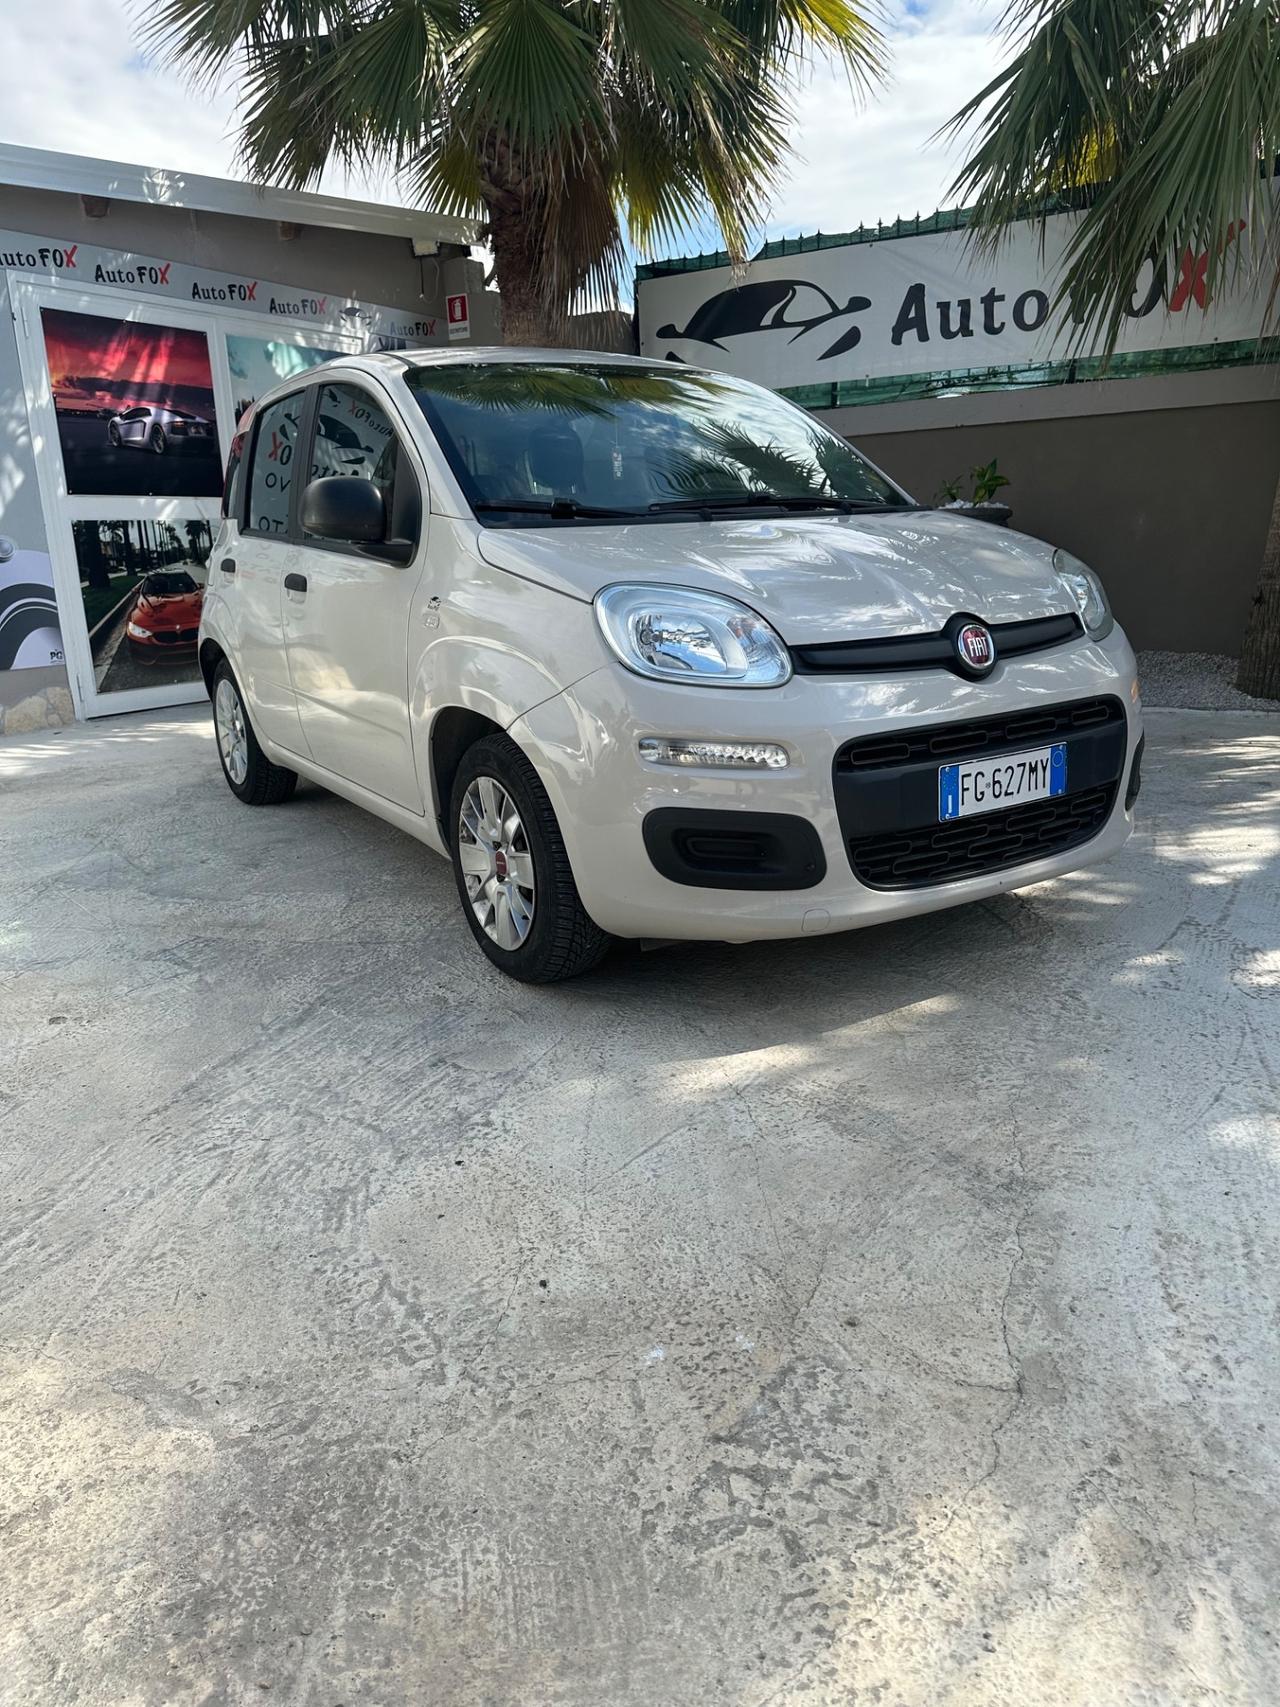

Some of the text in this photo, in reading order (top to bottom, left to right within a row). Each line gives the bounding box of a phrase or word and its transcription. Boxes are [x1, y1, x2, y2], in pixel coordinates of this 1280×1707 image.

[0, 245, 78, 268] uto FOX
[95, 263, 171, 285] Auto FOX
[192, 280, 257, 302] Auto FOX
[269, 296, 327, 316] Auto FOX
[891, 282, 1050, 345] Auto
[390, 321, 414, 336] Auto
[415, 319, 436, 337] FOX
[967, 636, 988, 657] FIAT
